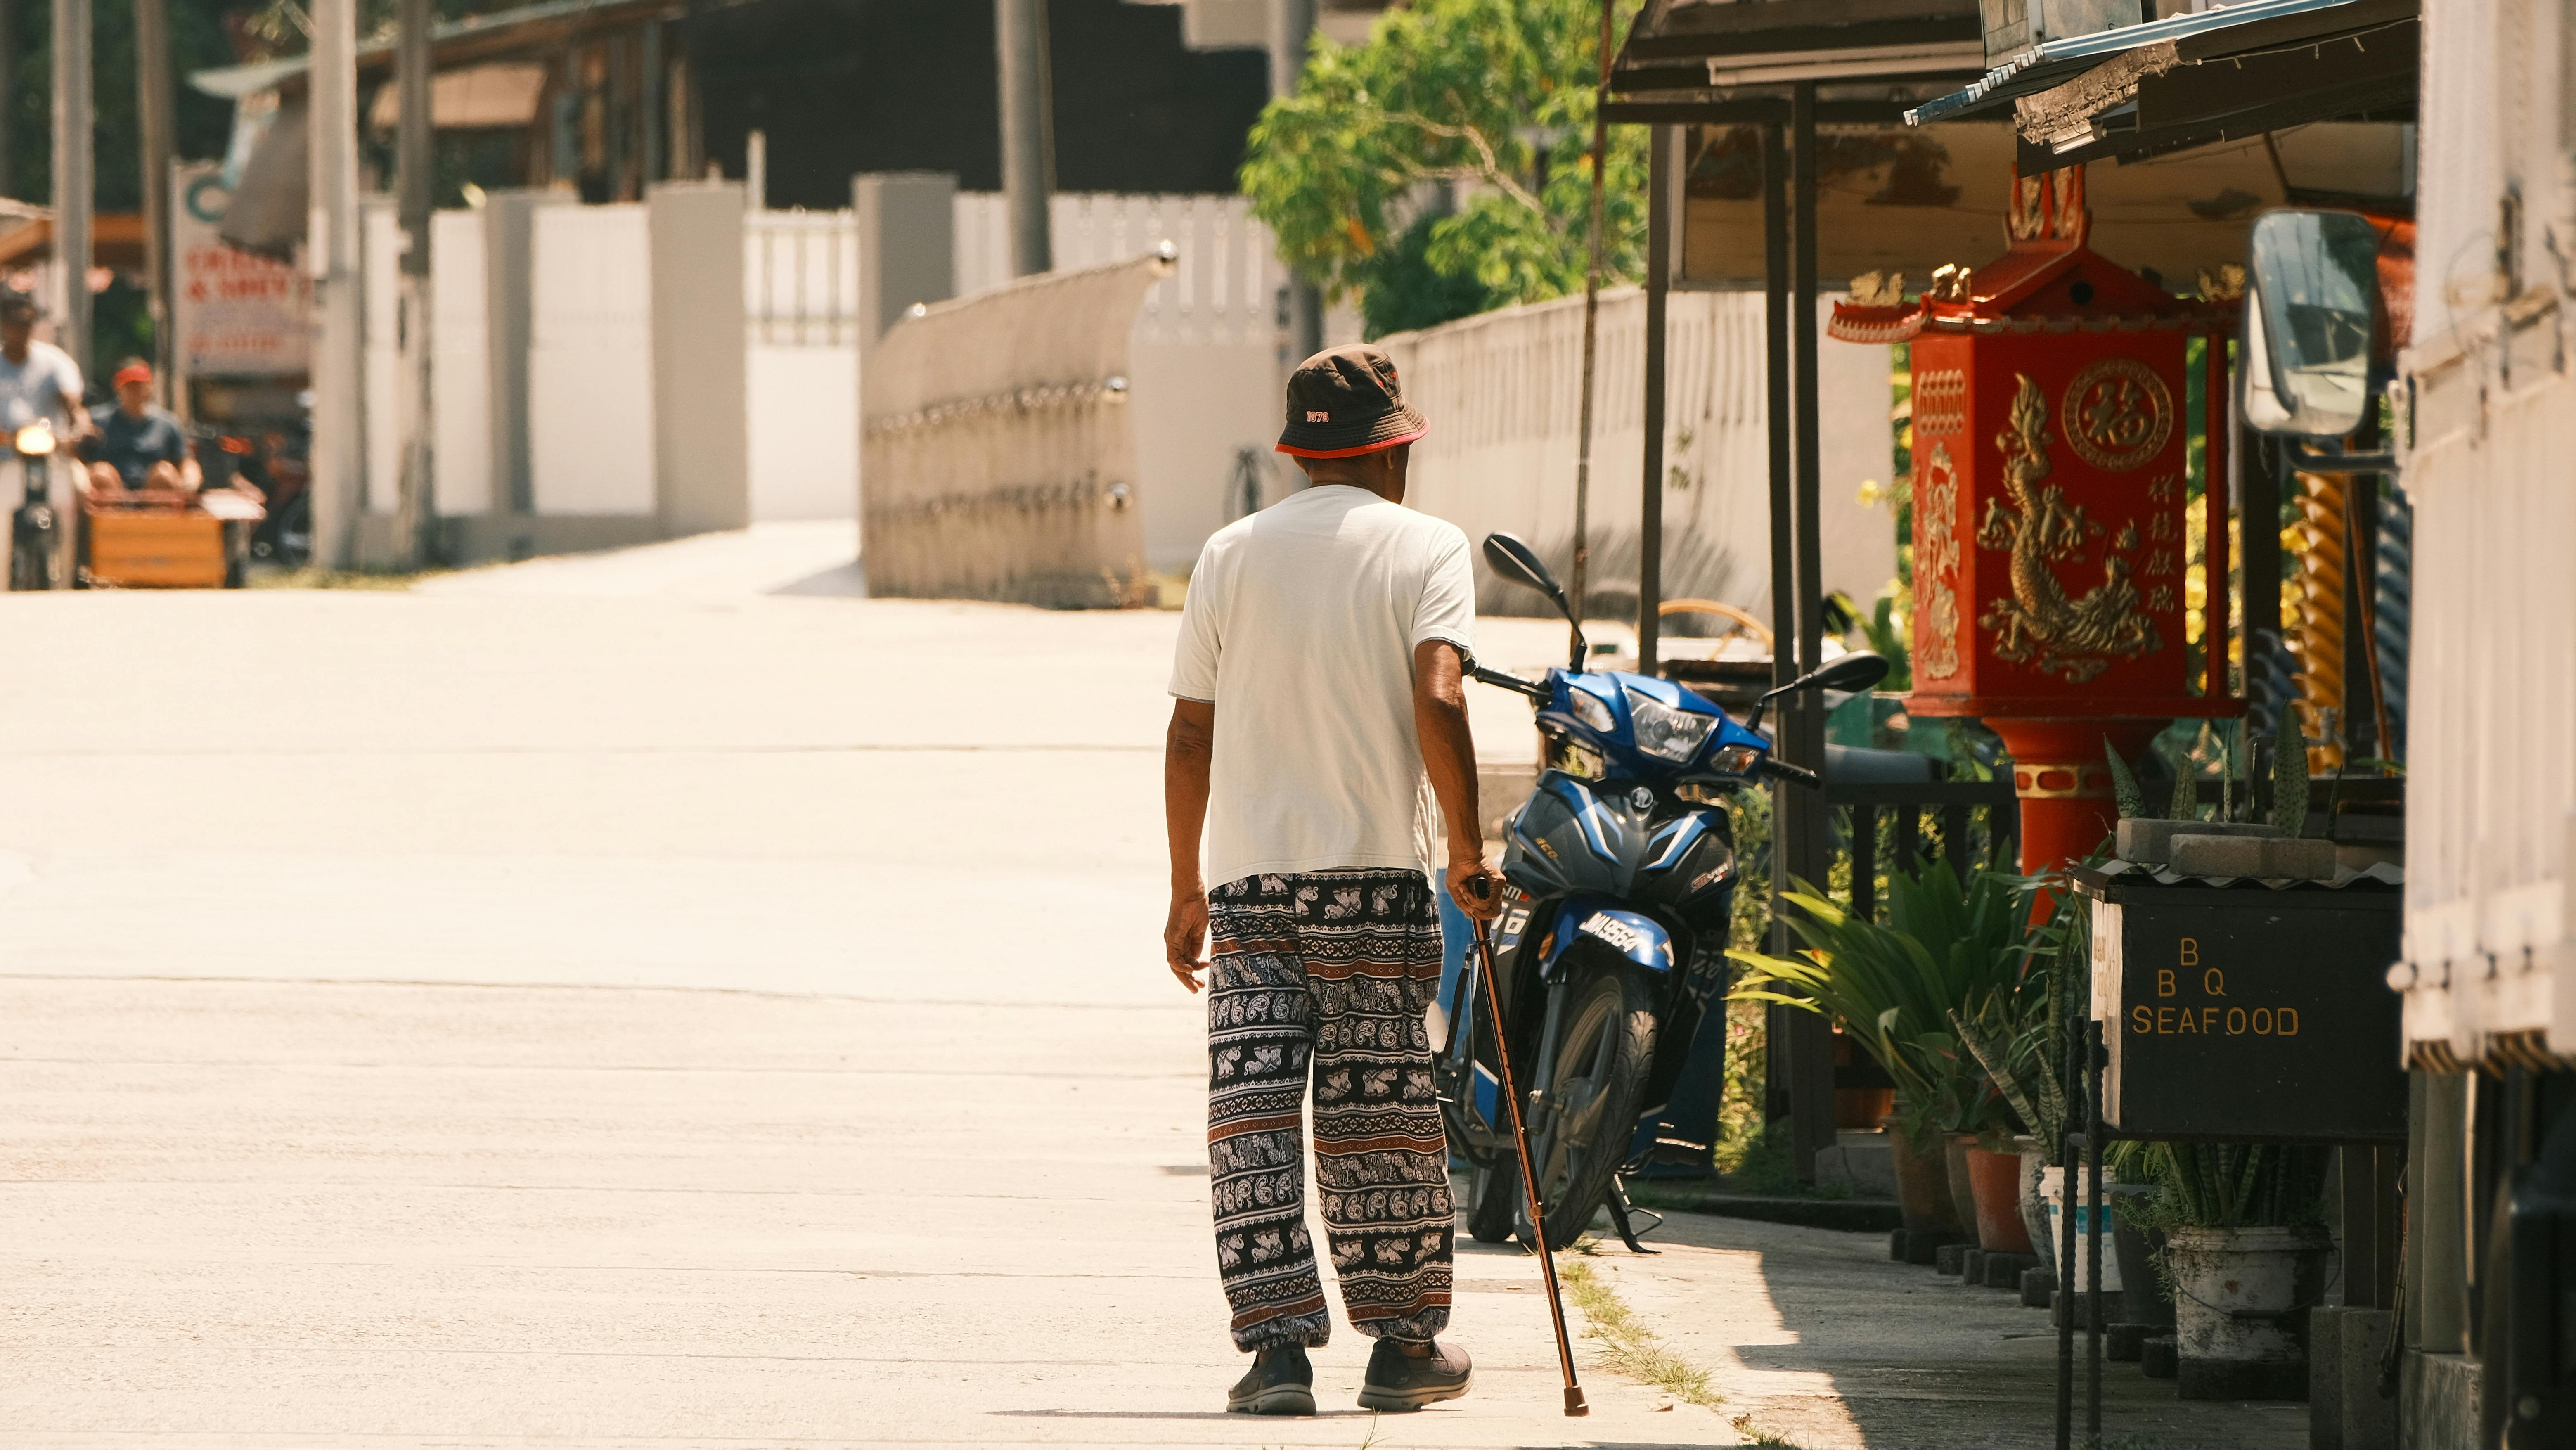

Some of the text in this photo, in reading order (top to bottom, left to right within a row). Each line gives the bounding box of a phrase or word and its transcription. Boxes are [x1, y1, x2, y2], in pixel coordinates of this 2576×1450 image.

[1307, 411, 1329, 422] 1878
[2084, 378, 2150, 446] 福
[2181, 938, 2199, 966] B
[2204, 967, 2228, 996] Q
[2132, 1005, 2299, 1036] SEAFOOD
